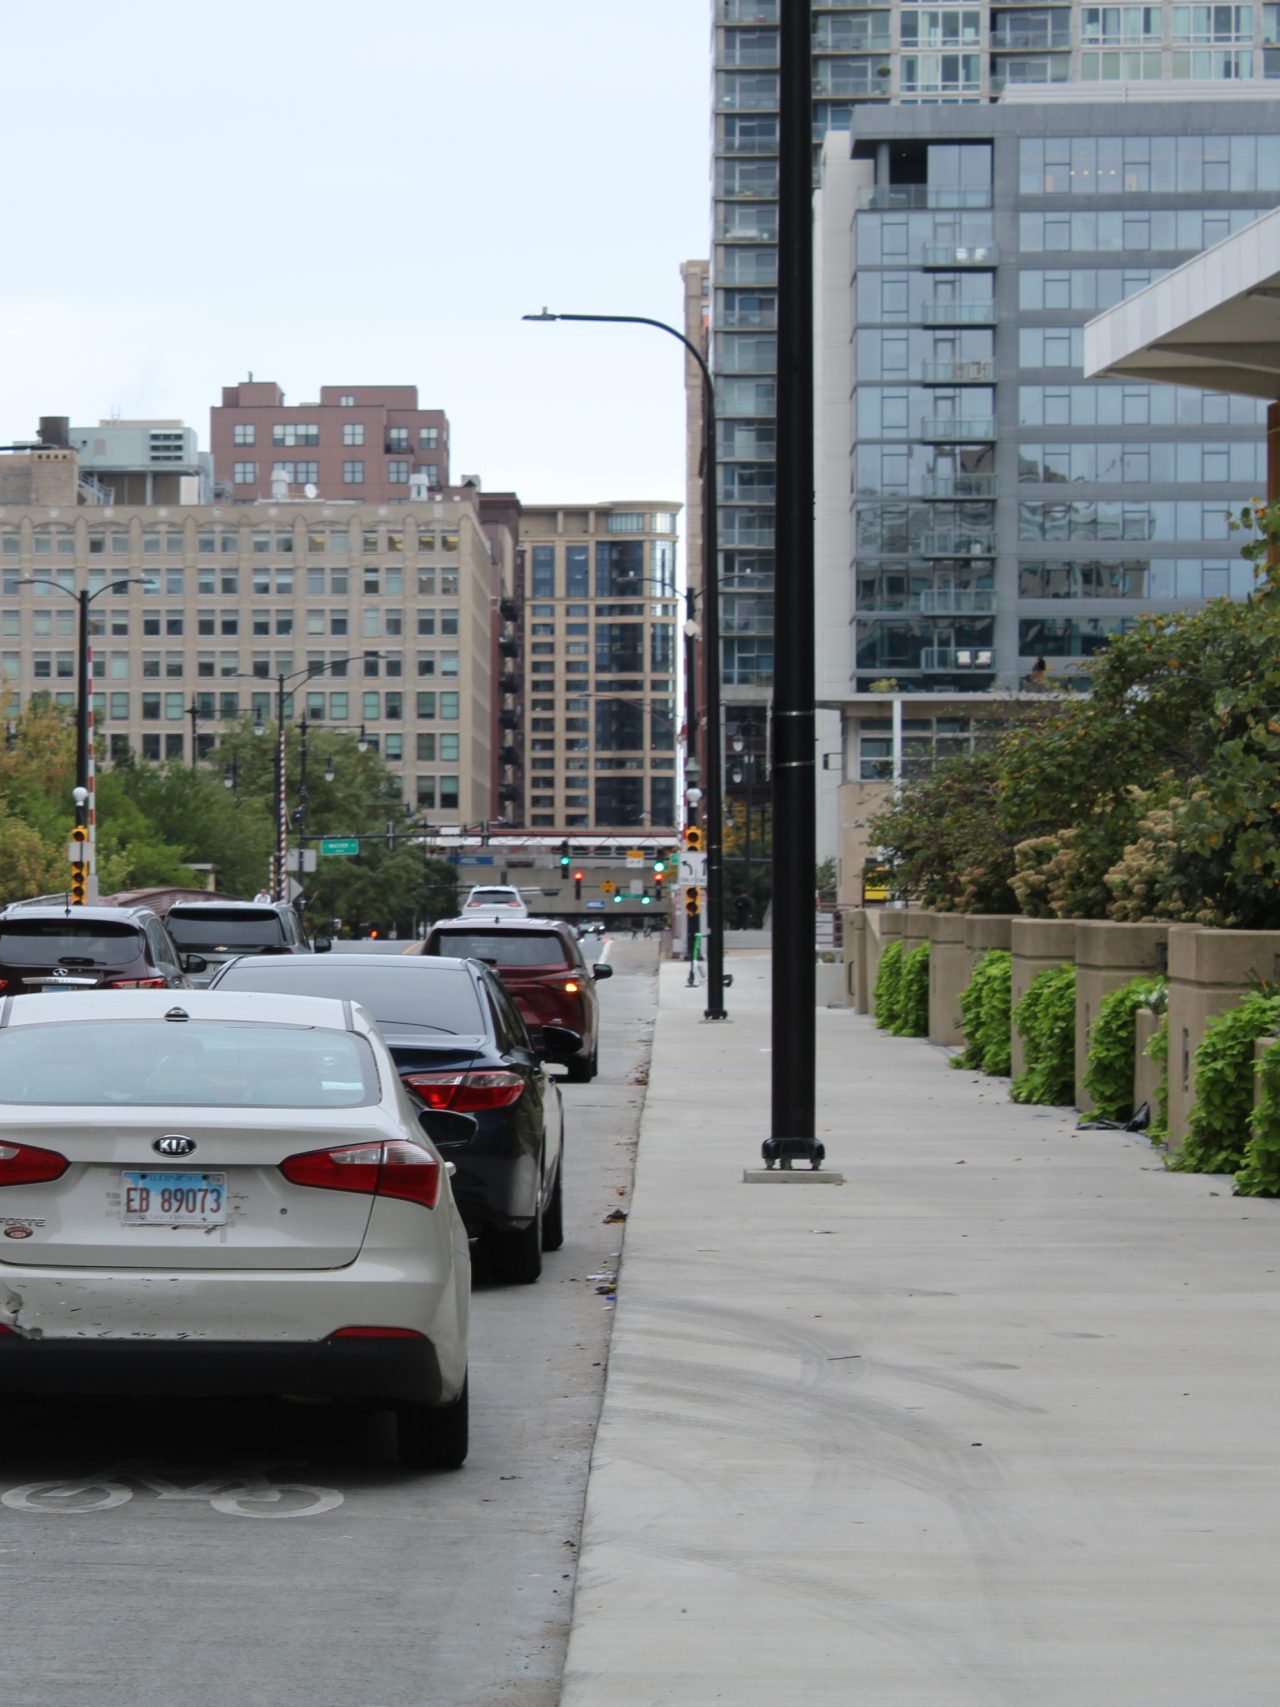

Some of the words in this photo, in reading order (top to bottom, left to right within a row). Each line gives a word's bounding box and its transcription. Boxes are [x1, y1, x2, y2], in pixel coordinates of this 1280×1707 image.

[159, 1139, 190, 1153] KIA
[126, 1187, 150, 1213] EB
[160, 1187, 222, 1214] 89073
